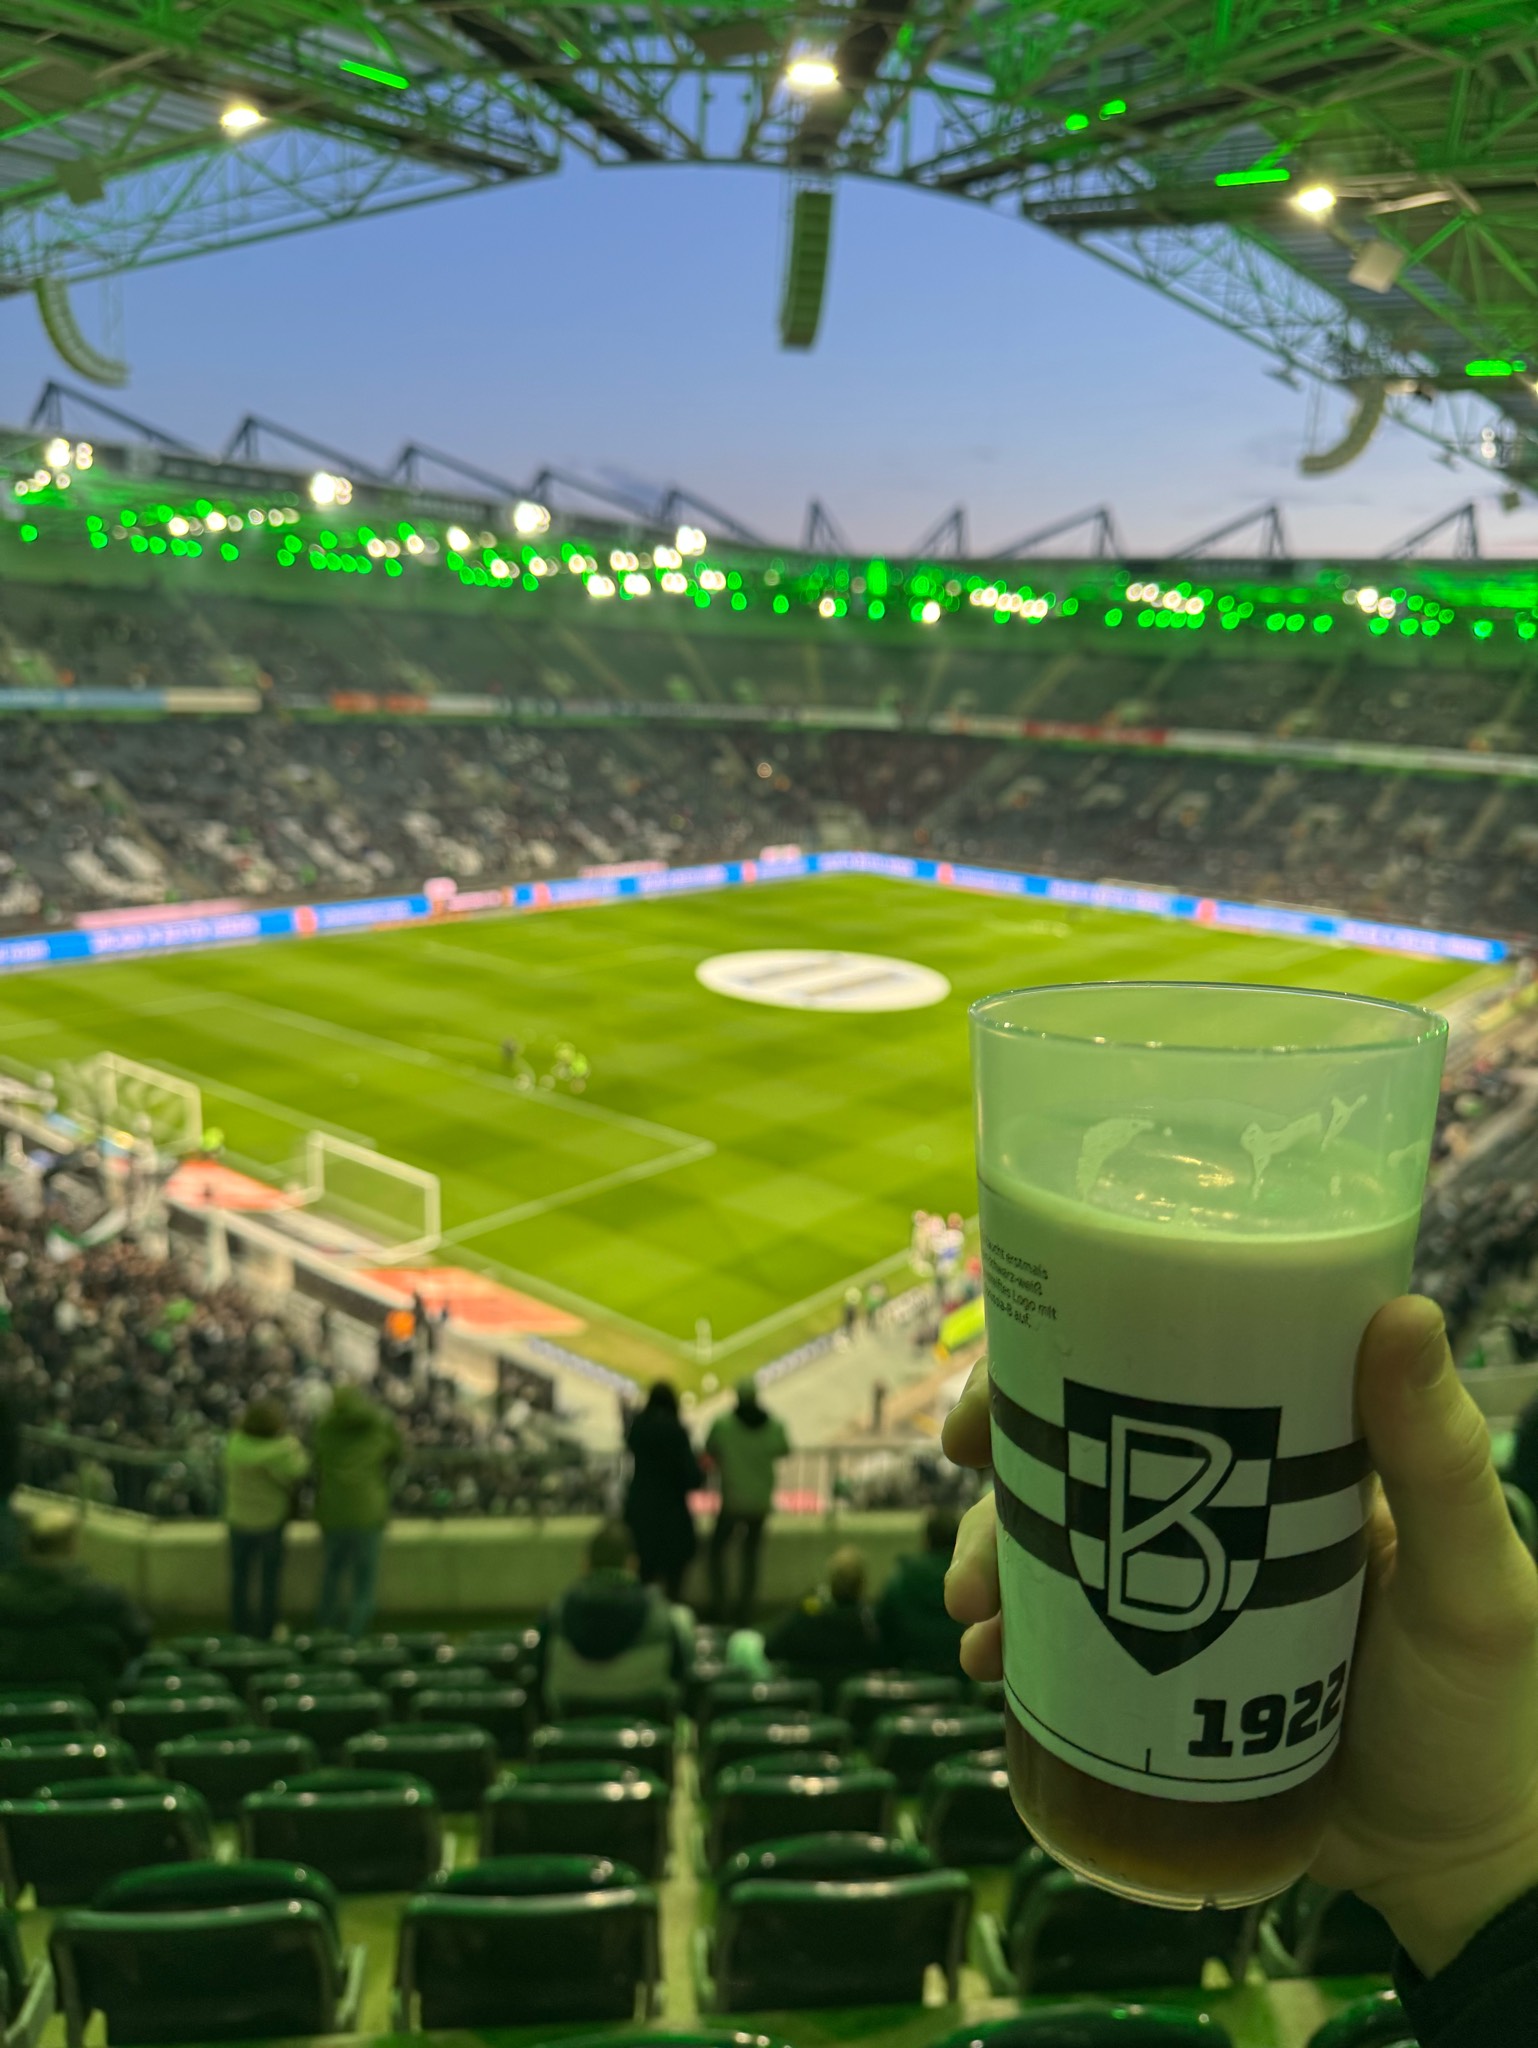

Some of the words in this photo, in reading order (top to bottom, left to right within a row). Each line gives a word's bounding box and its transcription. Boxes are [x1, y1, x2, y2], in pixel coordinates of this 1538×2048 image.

[1012, 1290, 1036, 1312] Logo
[1038, 1304, 1058, 1321] mit
[1107, 1414, 1233, 1632] B
[1188, 1660, 1347, 1758] 1922
